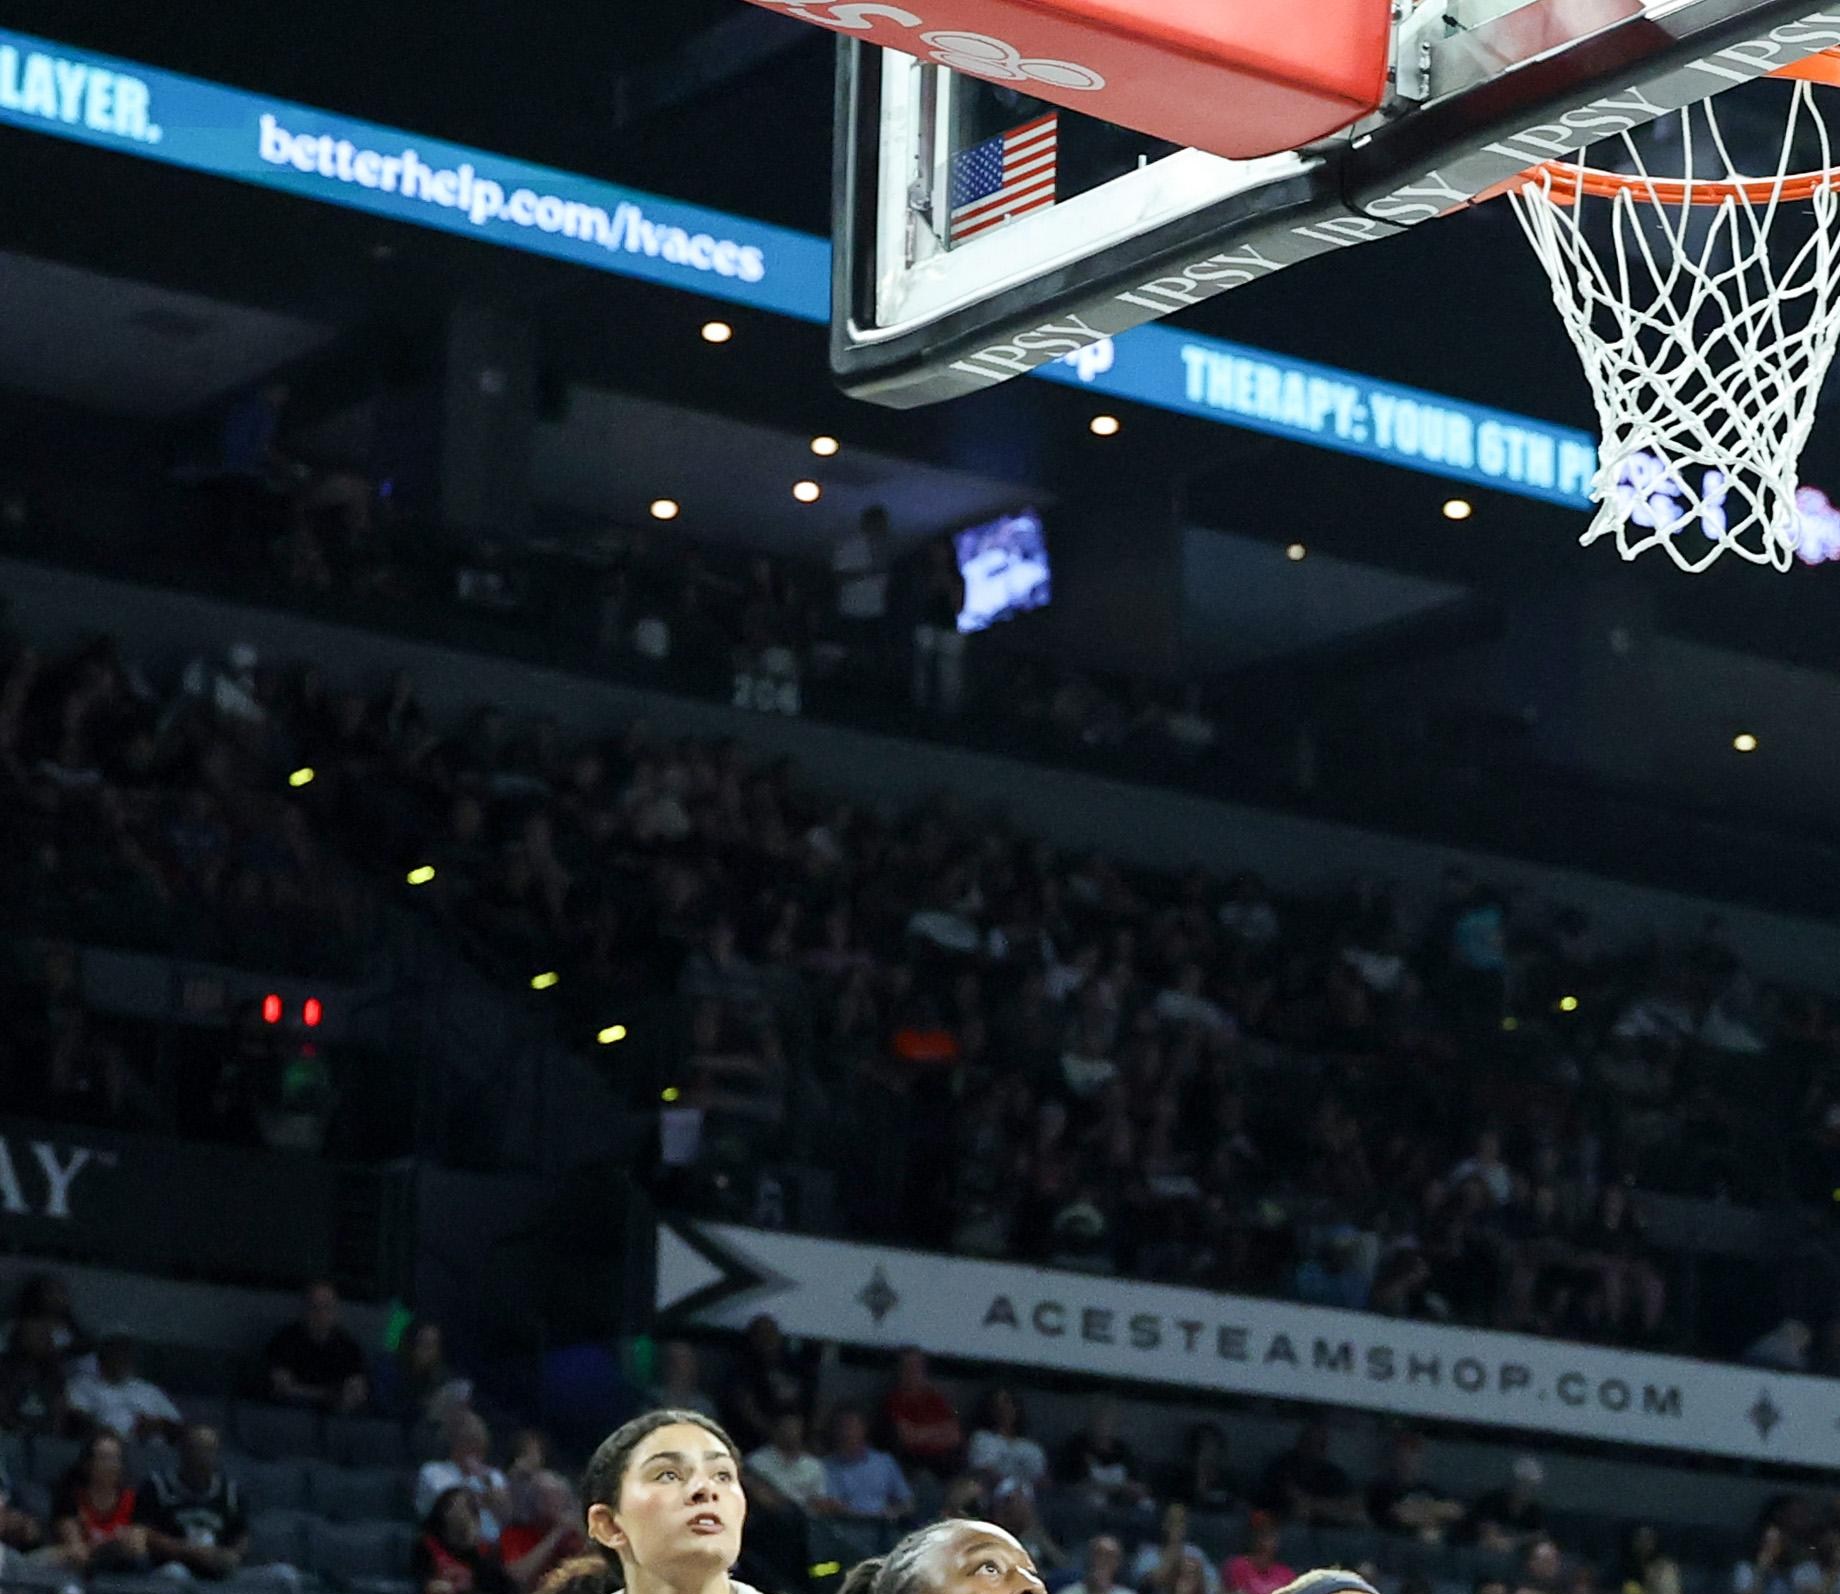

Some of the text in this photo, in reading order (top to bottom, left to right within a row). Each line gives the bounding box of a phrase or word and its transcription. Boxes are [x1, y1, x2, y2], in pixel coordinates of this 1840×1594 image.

[1483, 86, 1674, 166] IPSY
[258, 113, 766, 283] betterhelp.com/lvaces
[1292, 169, 1470, 249] IPSY
[1115, 242, 1285, 318] IPSY
[950, 313, 1111, 384] IPSY
[1181, 343, 1368, 442] THERAPY:
[1367, 391, 1475, 470] YOUR
[1476, 419, 1557, 489] 6TH
[980, 1294, 1683, 1418] ACESTEAMSHOP.COM
